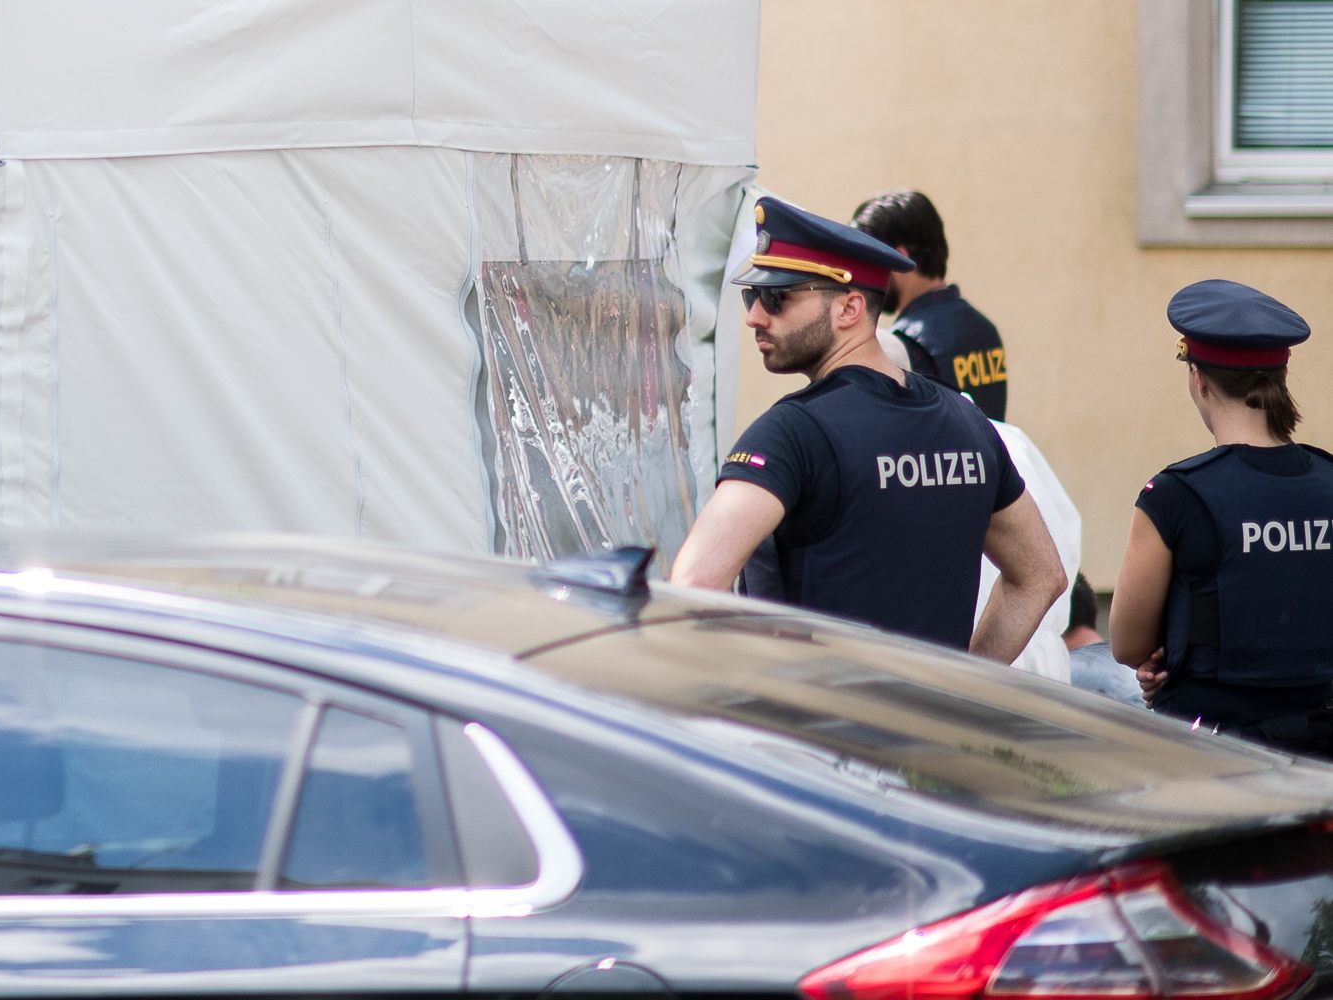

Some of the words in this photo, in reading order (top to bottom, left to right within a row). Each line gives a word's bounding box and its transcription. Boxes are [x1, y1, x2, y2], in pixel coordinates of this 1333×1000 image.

[953, 348, 1008, 389] POLIZ
[877, 451, 986, 489] POLIZEI
[1241, 519, 1333, 553] POLIZ
